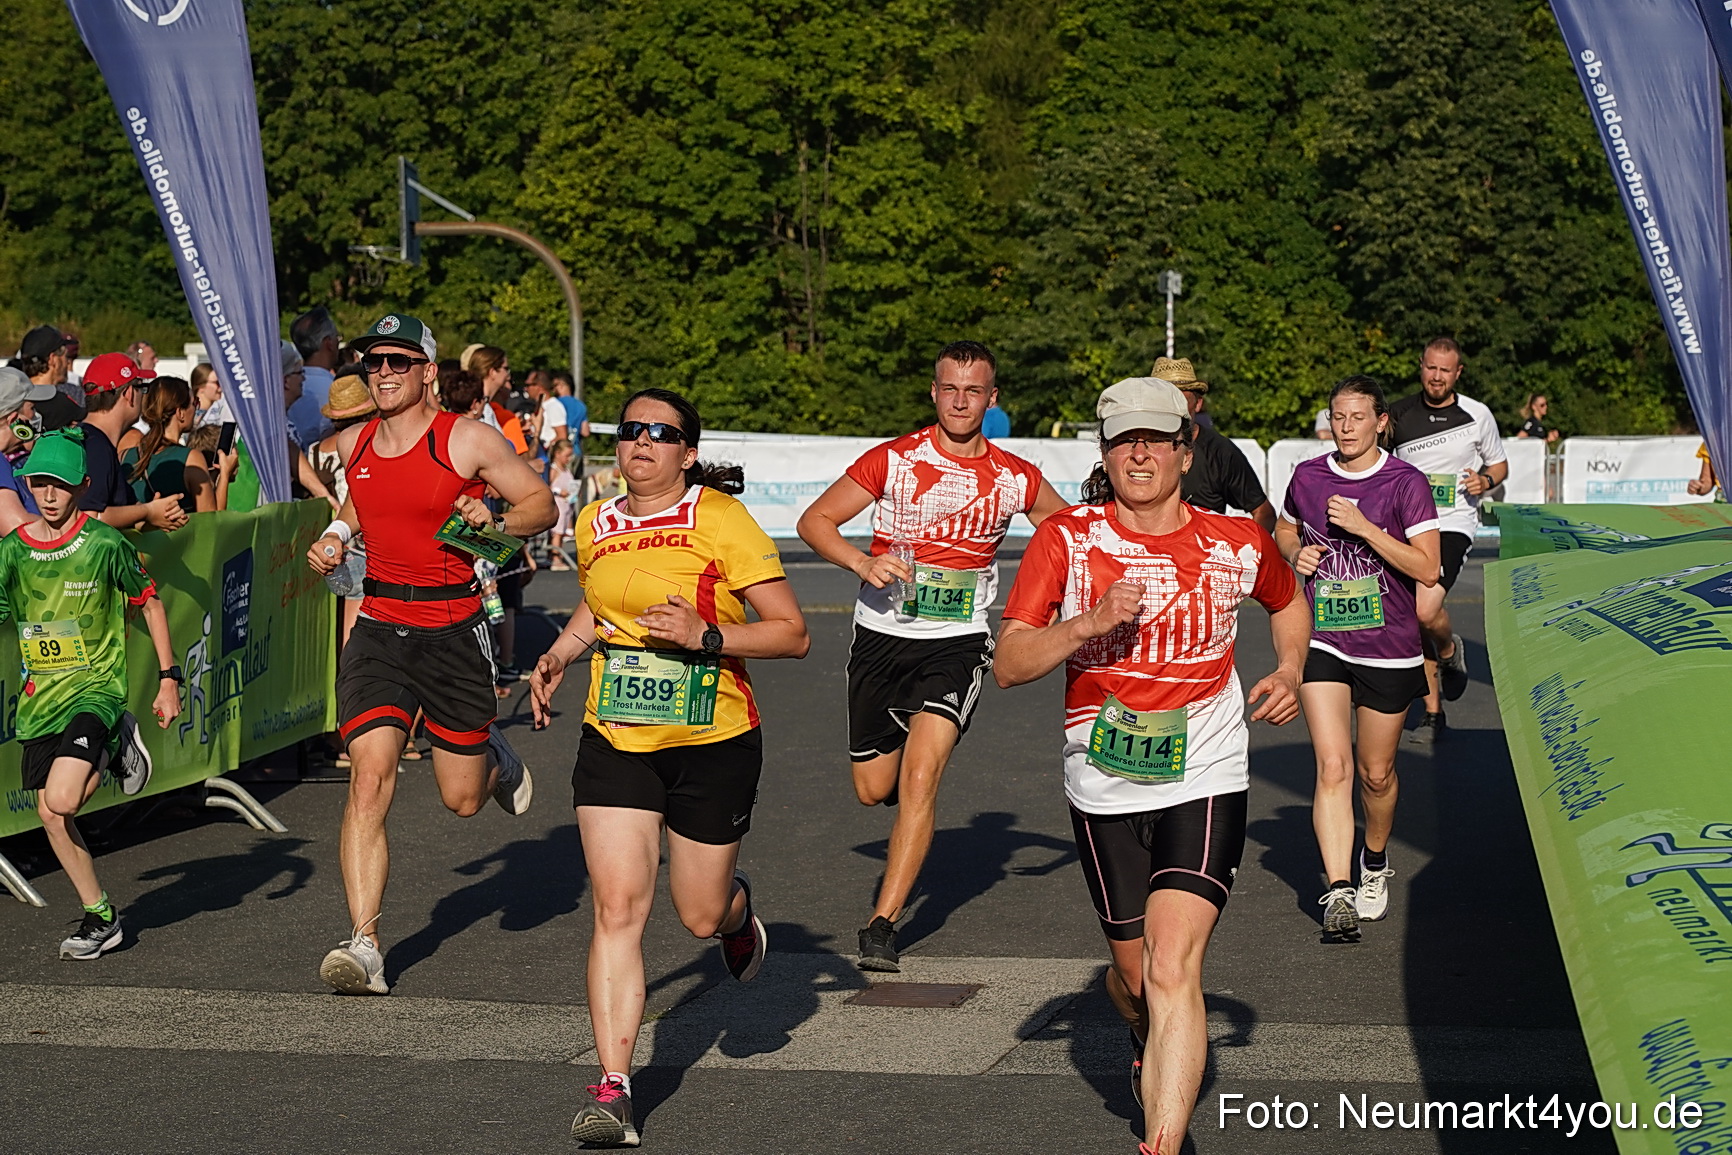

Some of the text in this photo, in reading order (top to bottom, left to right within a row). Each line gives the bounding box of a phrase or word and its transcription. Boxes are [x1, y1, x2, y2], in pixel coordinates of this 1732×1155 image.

[1407, 427, 1475, 454] INWOOD STYLE
[1587, 459, 1622, 473] NOW
[30, 535, 87, 562] MONSTERSTARK
[637, 530, 694, 550] BÖGL
[1118, 547, 1146, 556] 10.54
[919, 585, 964, 605] 1134
[963, 591, 972, 615] 2022
[1325, 596, 1370, 615] 1561
[1325, 615, 1346, 623] Ziegler
[1371, 596, 1381, 620] 2022
[23, 643, 33, 668] WALK
[39, 640, 62, 657] 89
[51, 655, 79, 664] Matthias
[73, 639, 85, 662] 2022
[602, 682, 611, 706] RUN
[613, 675, 674, 701] 1589
[675, 683, 686, 716] 2022
[612, 700, 670, 711] Trost Marketa
[1093, 727, 1105, 753] RUN
[1107, 727, 1172, 758] 1114
[1100, 747, 1172, 769] Federsel Claudia
[1171, 737, 1184, 771] 2022
[1647, 887, 1732, 964] neumarkt
